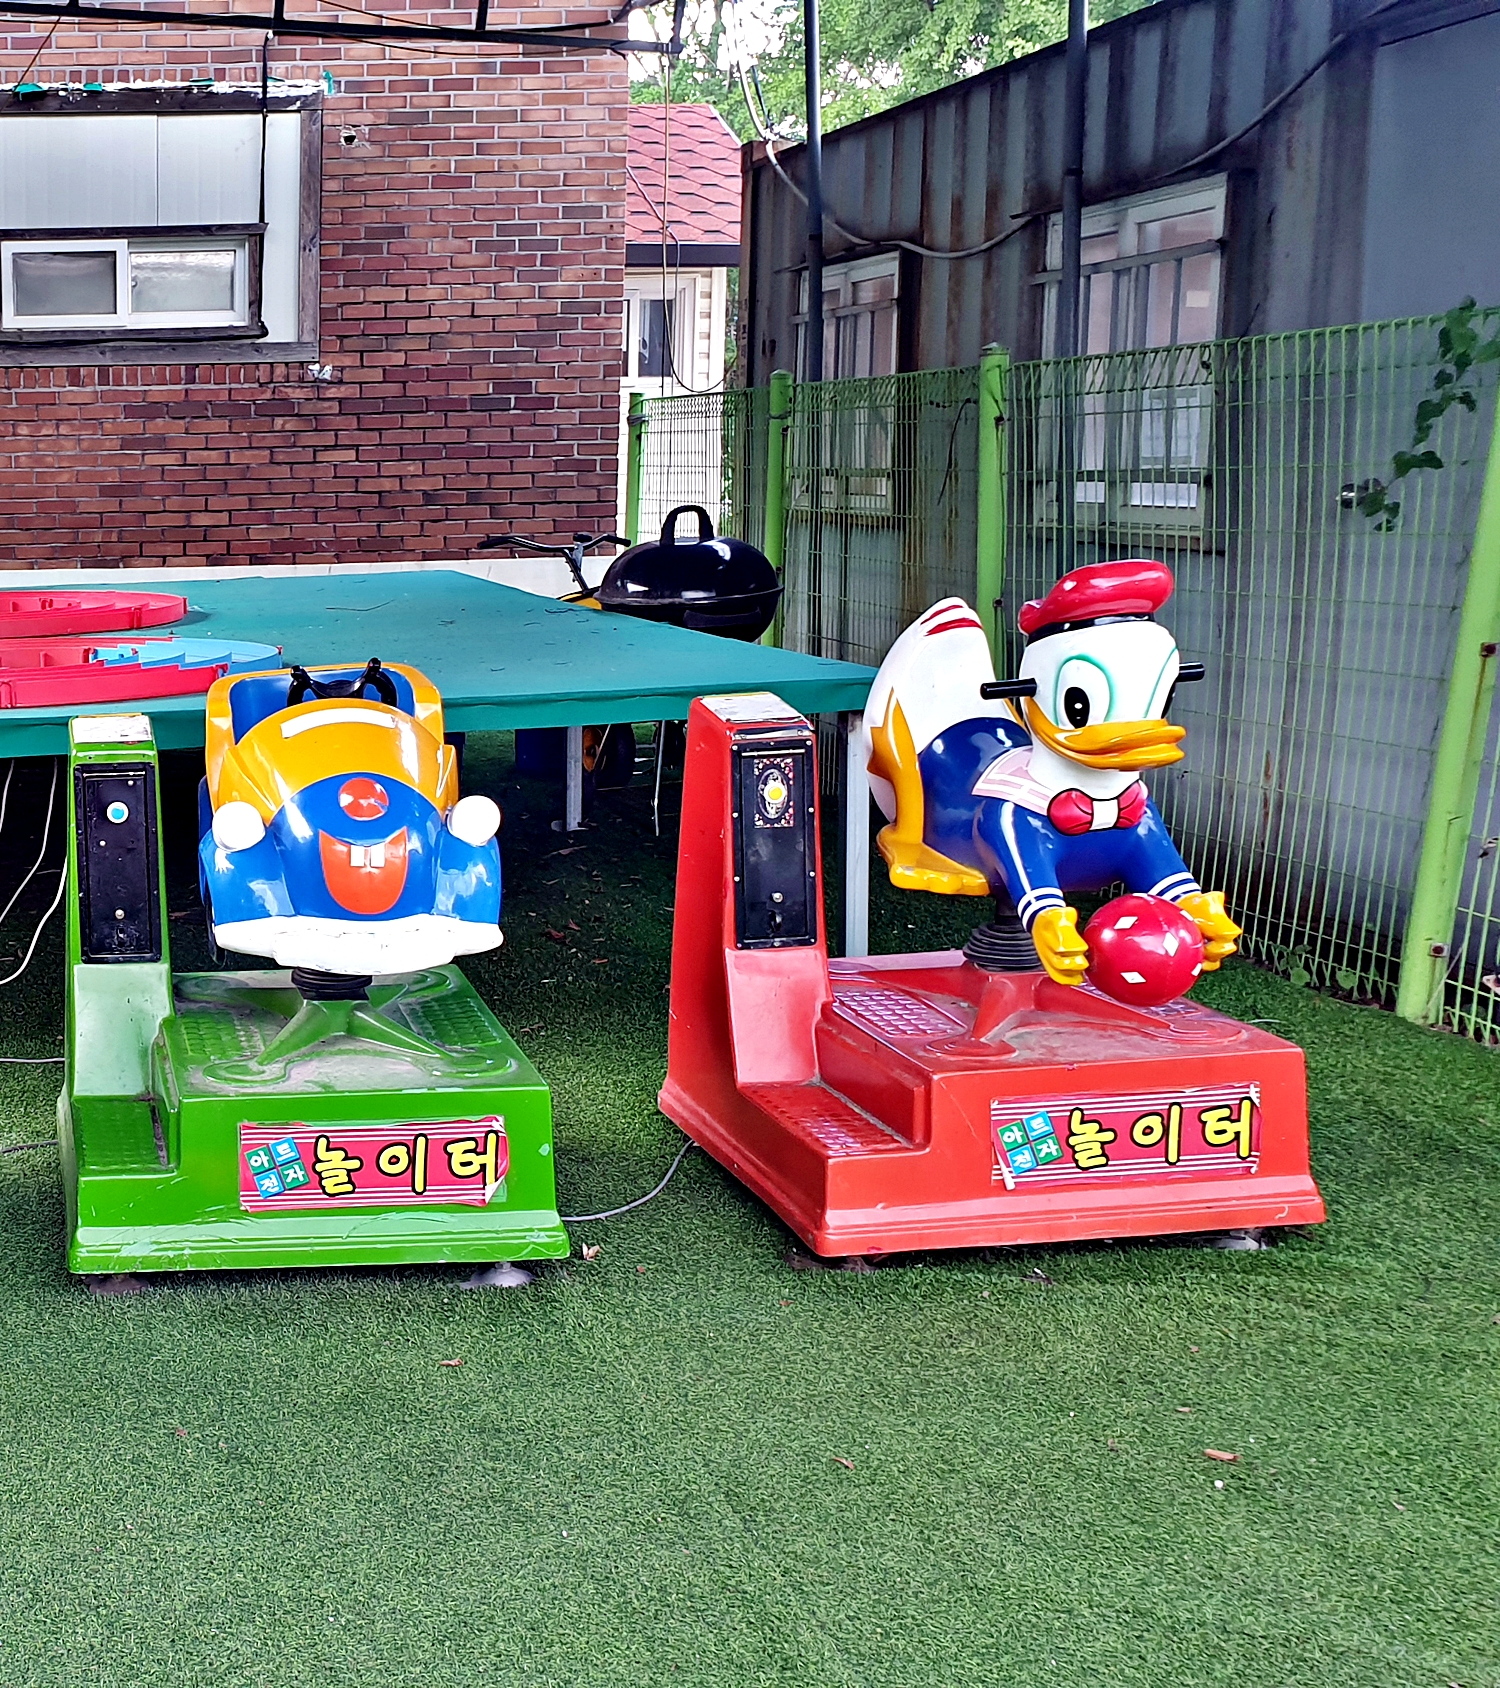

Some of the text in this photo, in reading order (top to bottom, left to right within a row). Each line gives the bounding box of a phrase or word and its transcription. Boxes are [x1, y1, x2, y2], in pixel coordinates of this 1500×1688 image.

[1002, 1116, 1050, 1144] 아트
[1066, 1097, 1254, 1171] 놀이터
[249, 1142, 296, 1168] 아트
[313, 1130, 500, 1197] 놀이터
[1012, 1139, 1059, 1168] 전자
[259, 1164, 305, 1193] 전자
